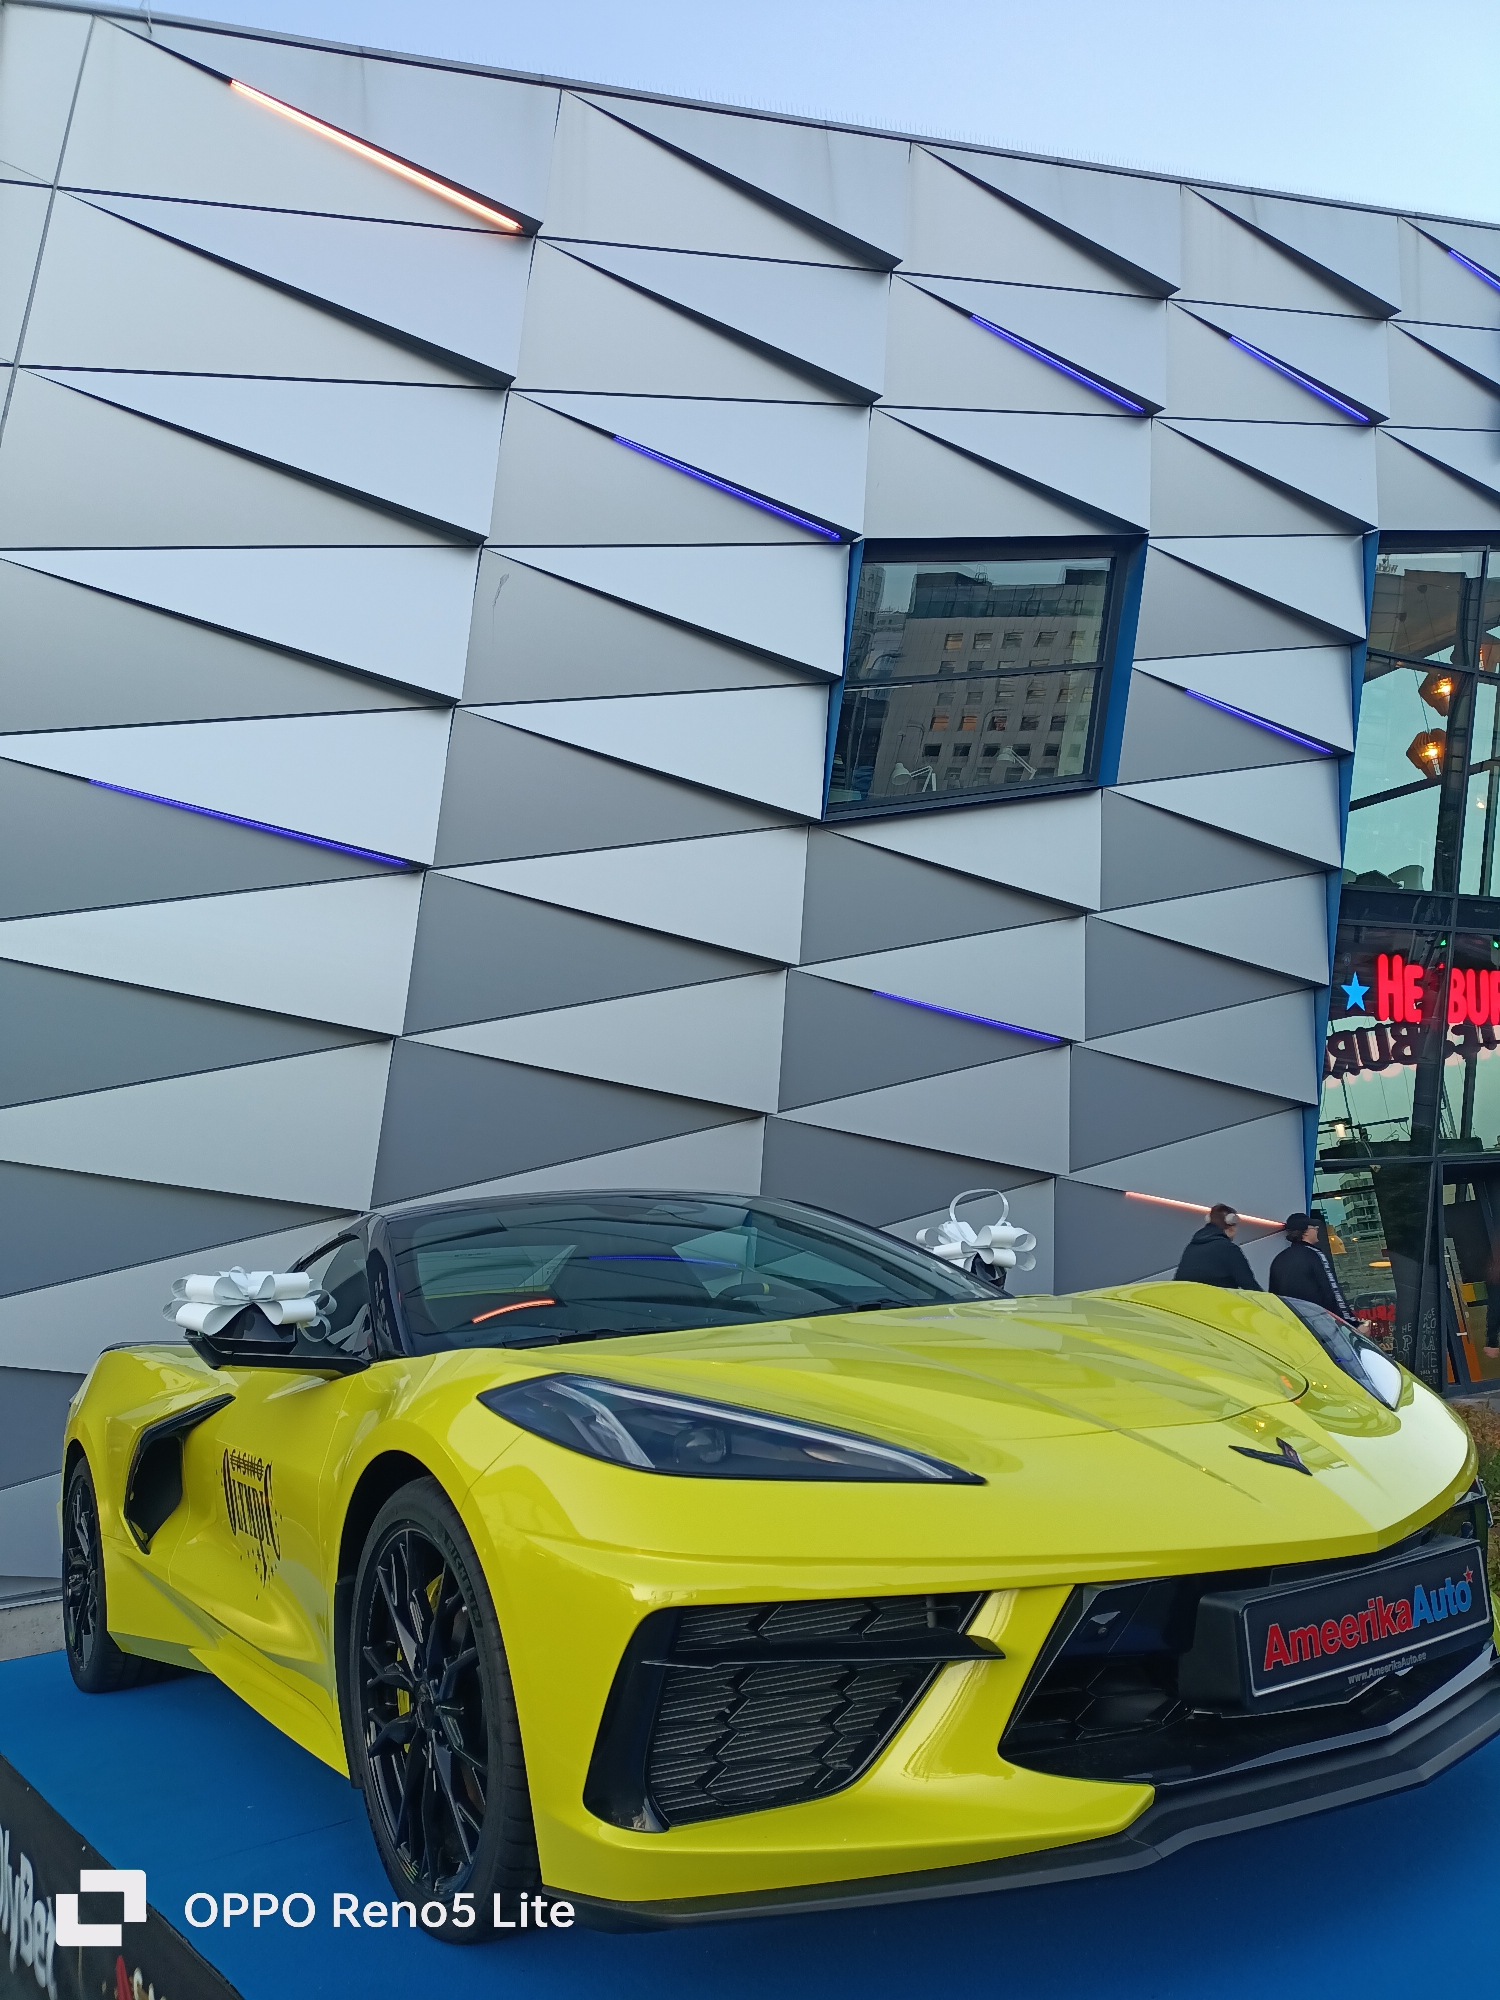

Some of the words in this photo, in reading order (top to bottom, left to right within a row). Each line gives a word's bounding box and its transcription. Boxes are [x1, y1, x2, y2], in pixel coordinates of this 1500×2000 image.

[229, 1448, 264, 1482] CASINO
[1263, 1576, 1473, 1671] AmeerikaAuto
[1347, 1650, 1428, 1685] www.AmeerikaAuto.ee
